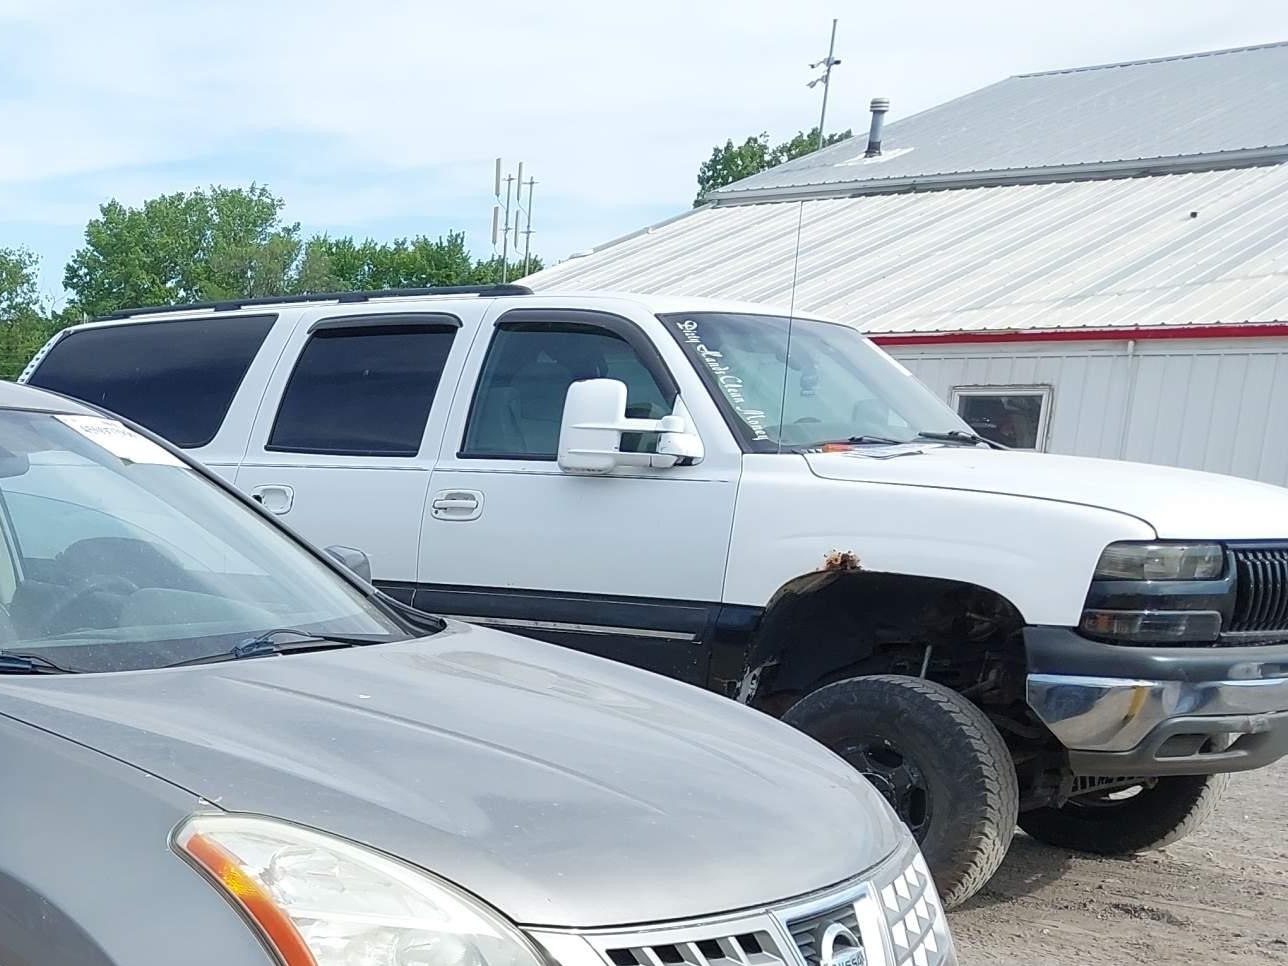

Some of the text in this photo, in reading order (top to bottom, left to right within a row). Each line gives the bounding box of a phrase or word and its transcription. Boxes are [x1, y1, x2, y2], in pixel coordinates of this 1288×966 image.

[676, 320, 769, 441] Dirty Hands Clean Money
